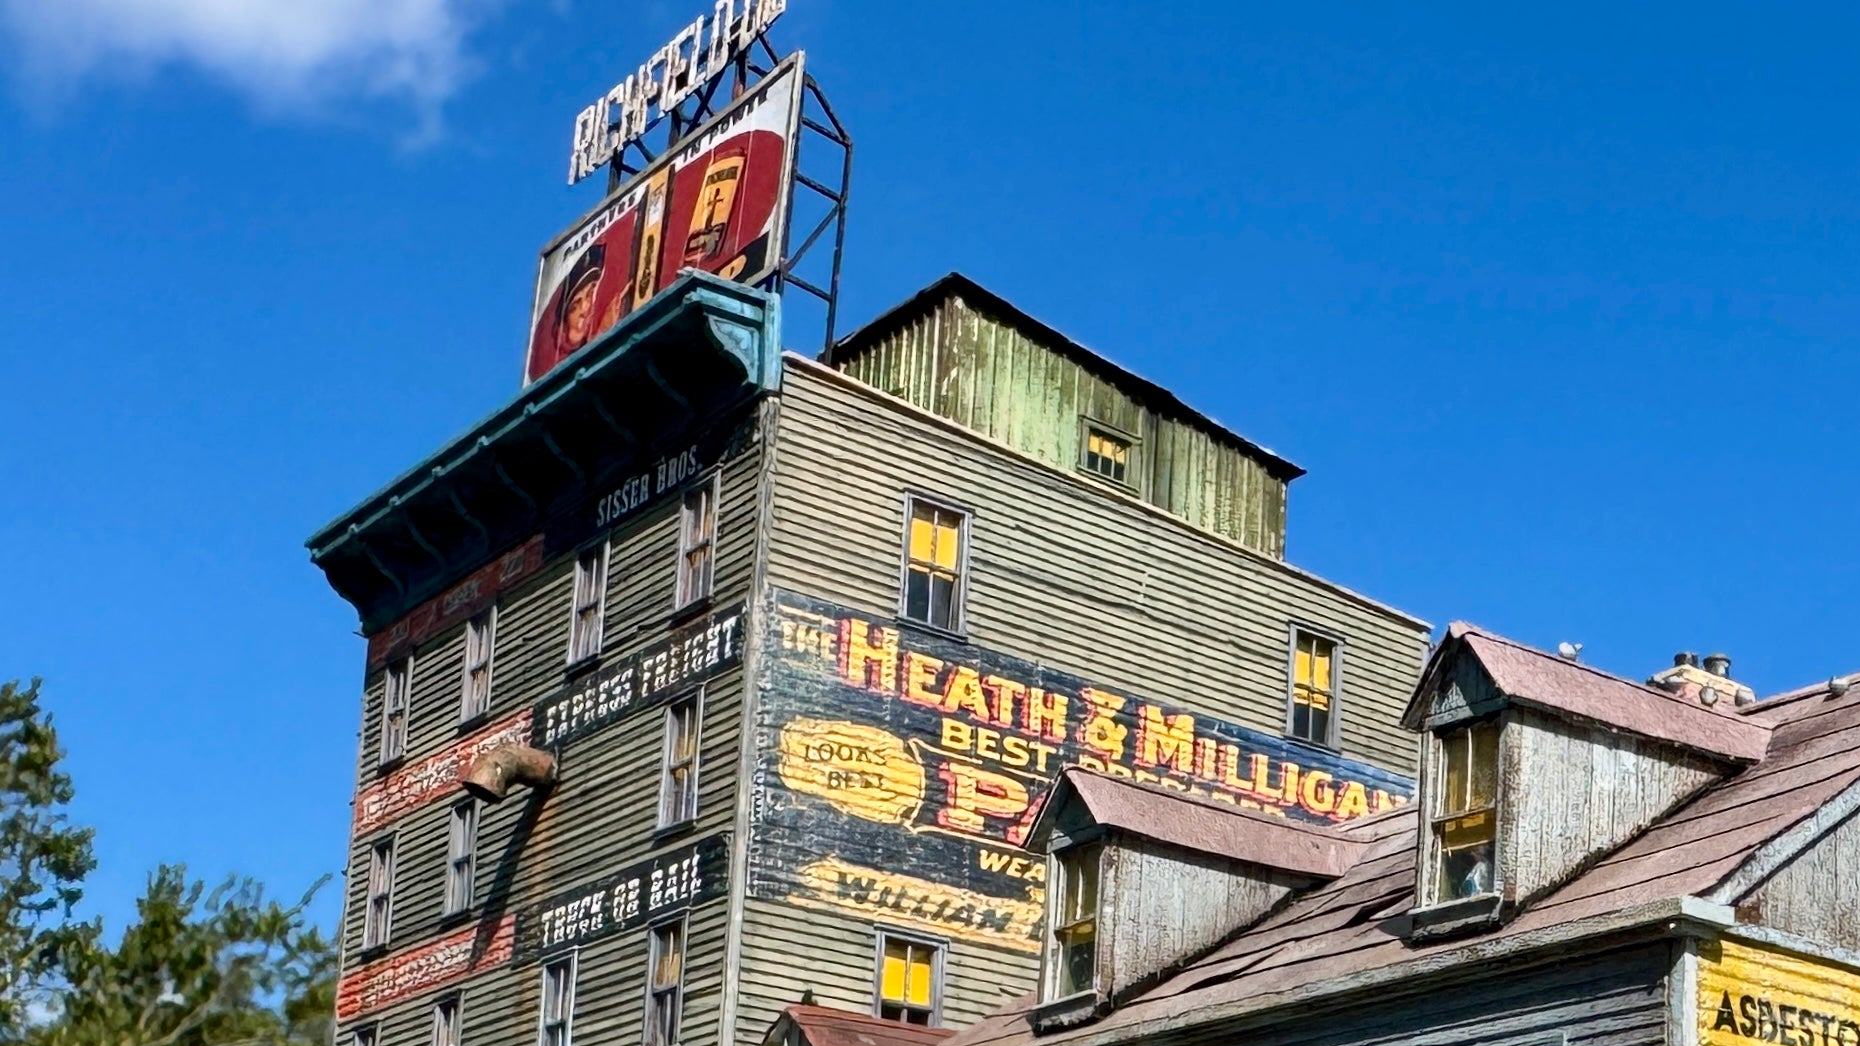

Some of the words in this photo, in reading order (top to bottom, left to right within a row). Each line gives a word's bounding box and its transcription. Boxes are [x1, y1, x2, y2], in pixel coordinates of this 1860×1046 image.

[598, 475, 650, 527] SISSER
[641, 614, 738, 699] FREIGHT
[780, 619, 838, 659] THE
[837, 617, 1069, 744] HEATH
[1080, 686, 1128, 761] &
[941, 717, 1057, 773] BEST
[541, 889, 604, 949] TRUCK
[612, 876, 641, 923] OR
[648, 854, 702, 911] RAIL
